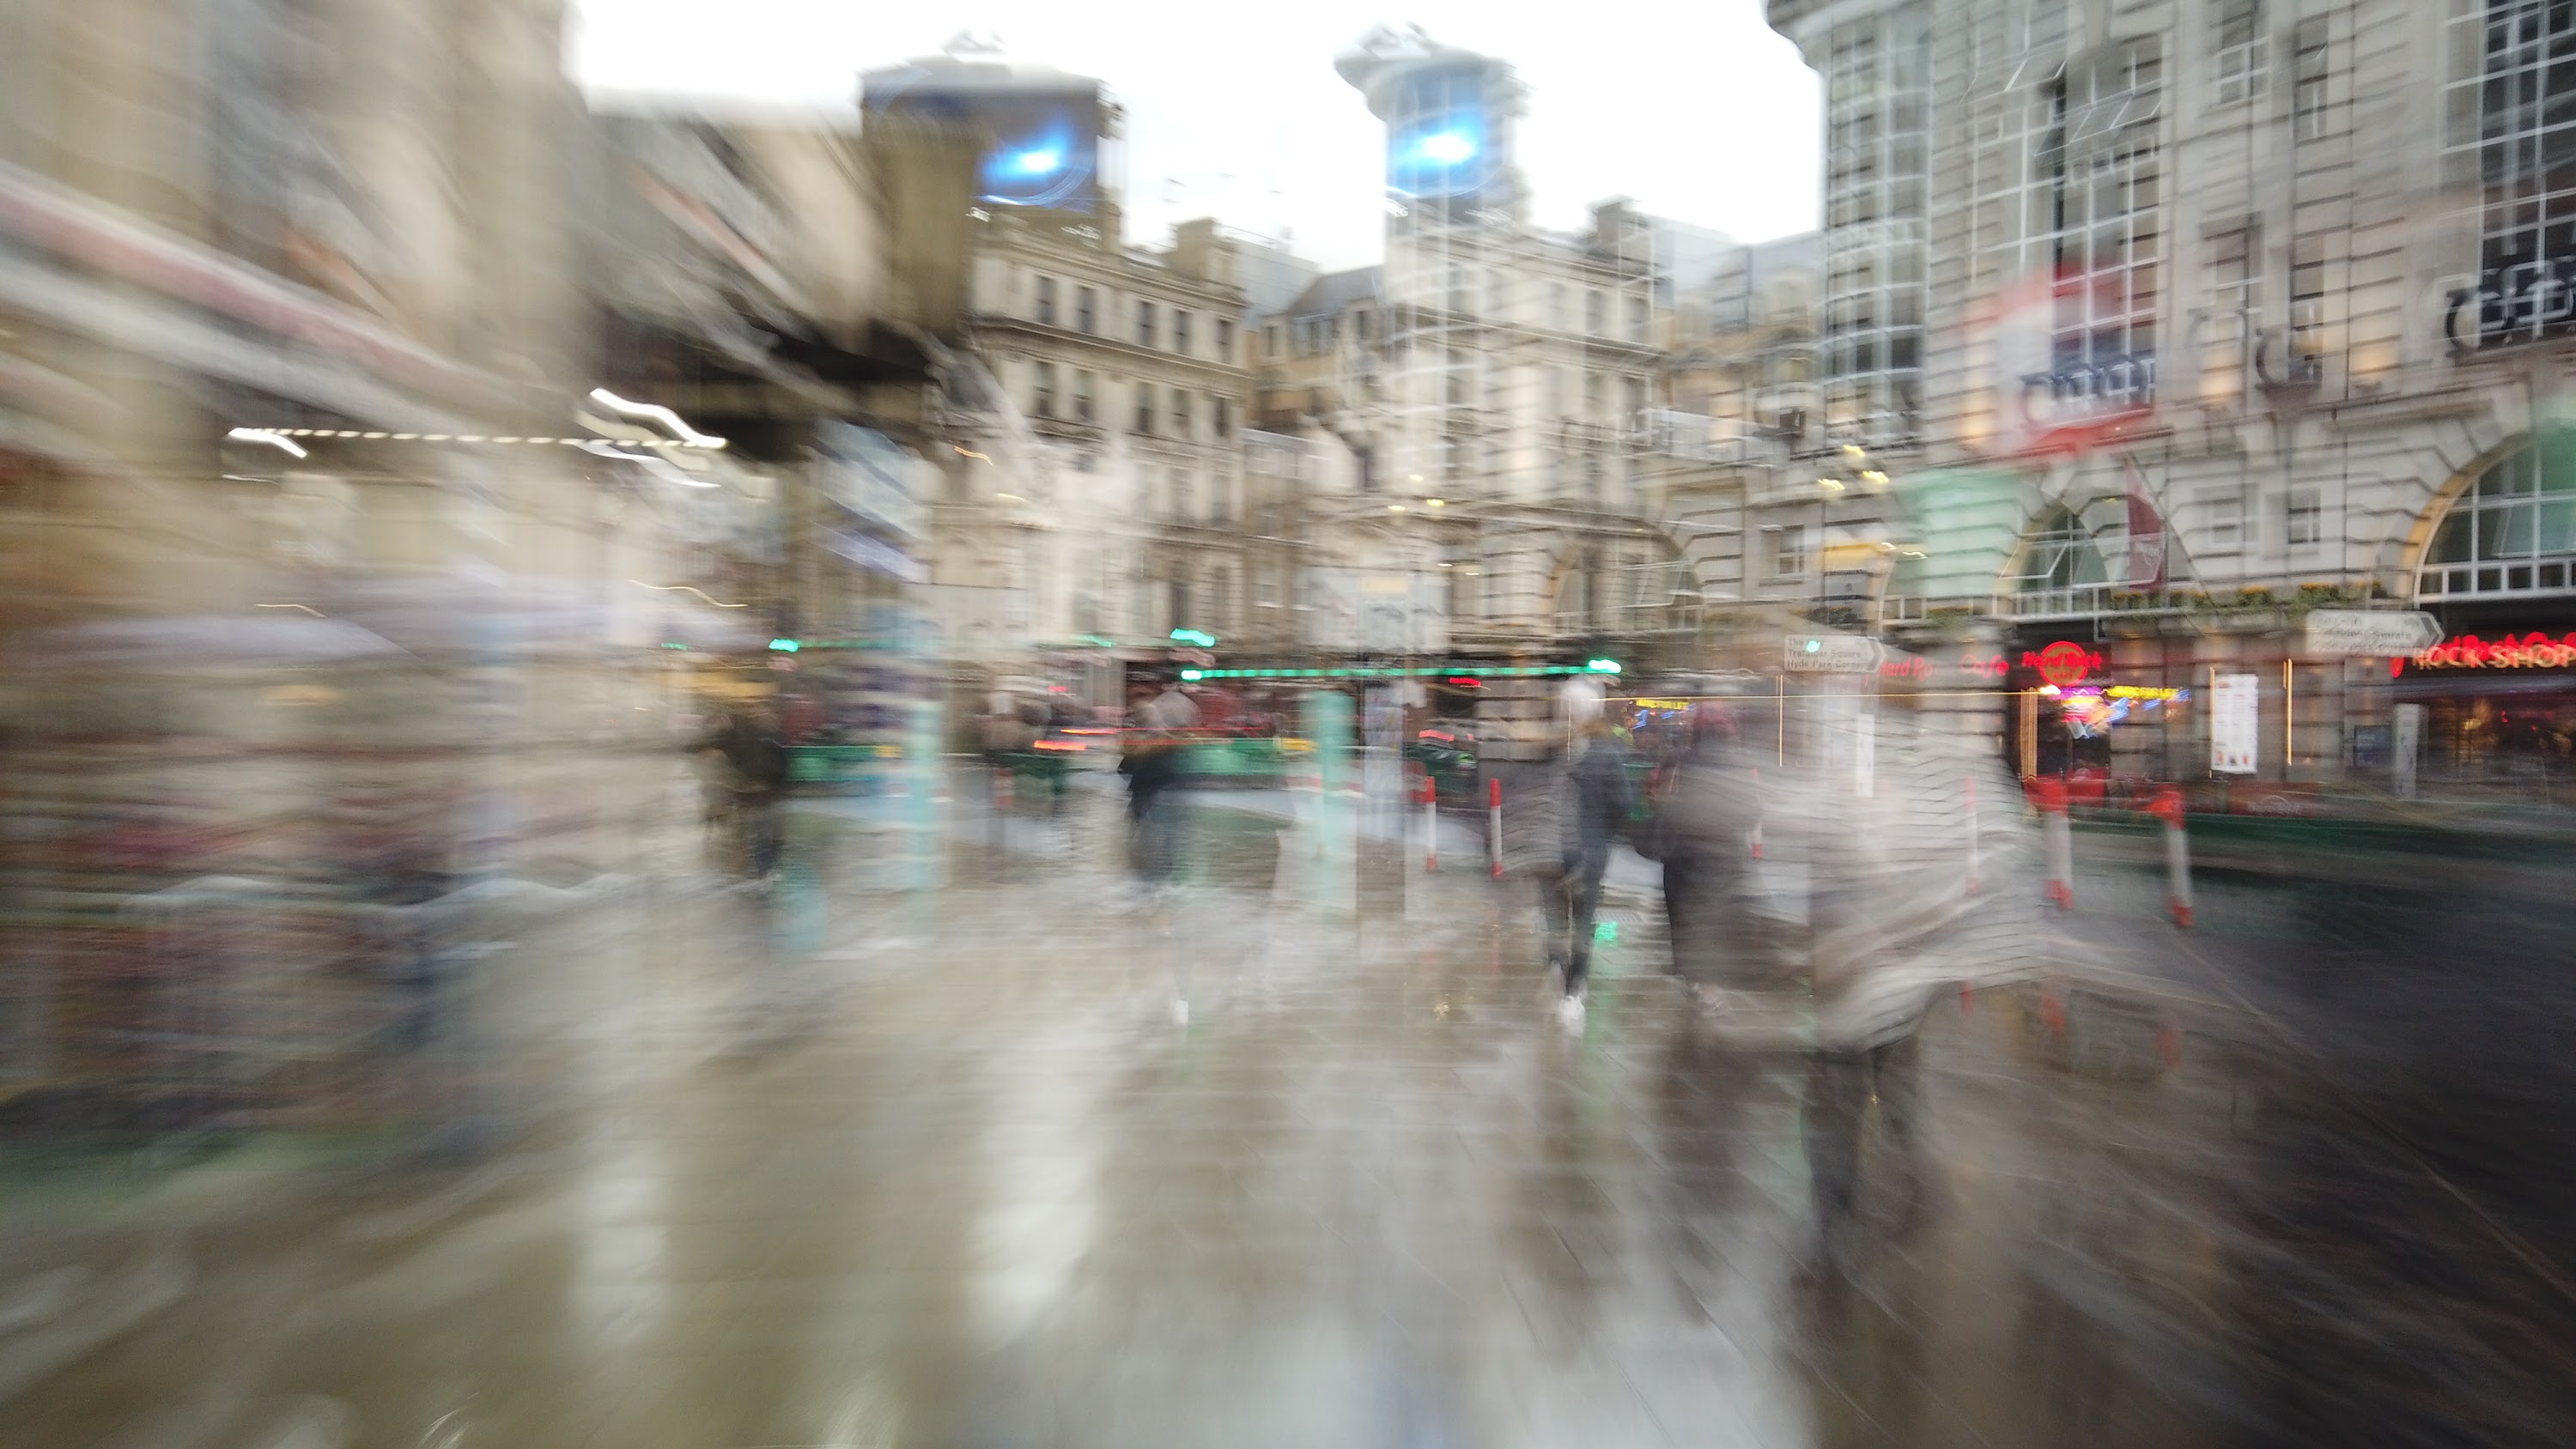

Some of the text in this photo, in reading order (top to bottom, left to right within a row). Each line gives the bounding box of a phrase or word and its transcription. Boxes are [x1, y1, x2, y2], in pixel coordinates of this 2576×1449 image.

[1830, 649, 1862, 659] Square
[1787, 659, 1807, 669] Hyde
[1813, 659, 1831, 668] Park
[2021, 651, 2103, 670] Hard Rock
